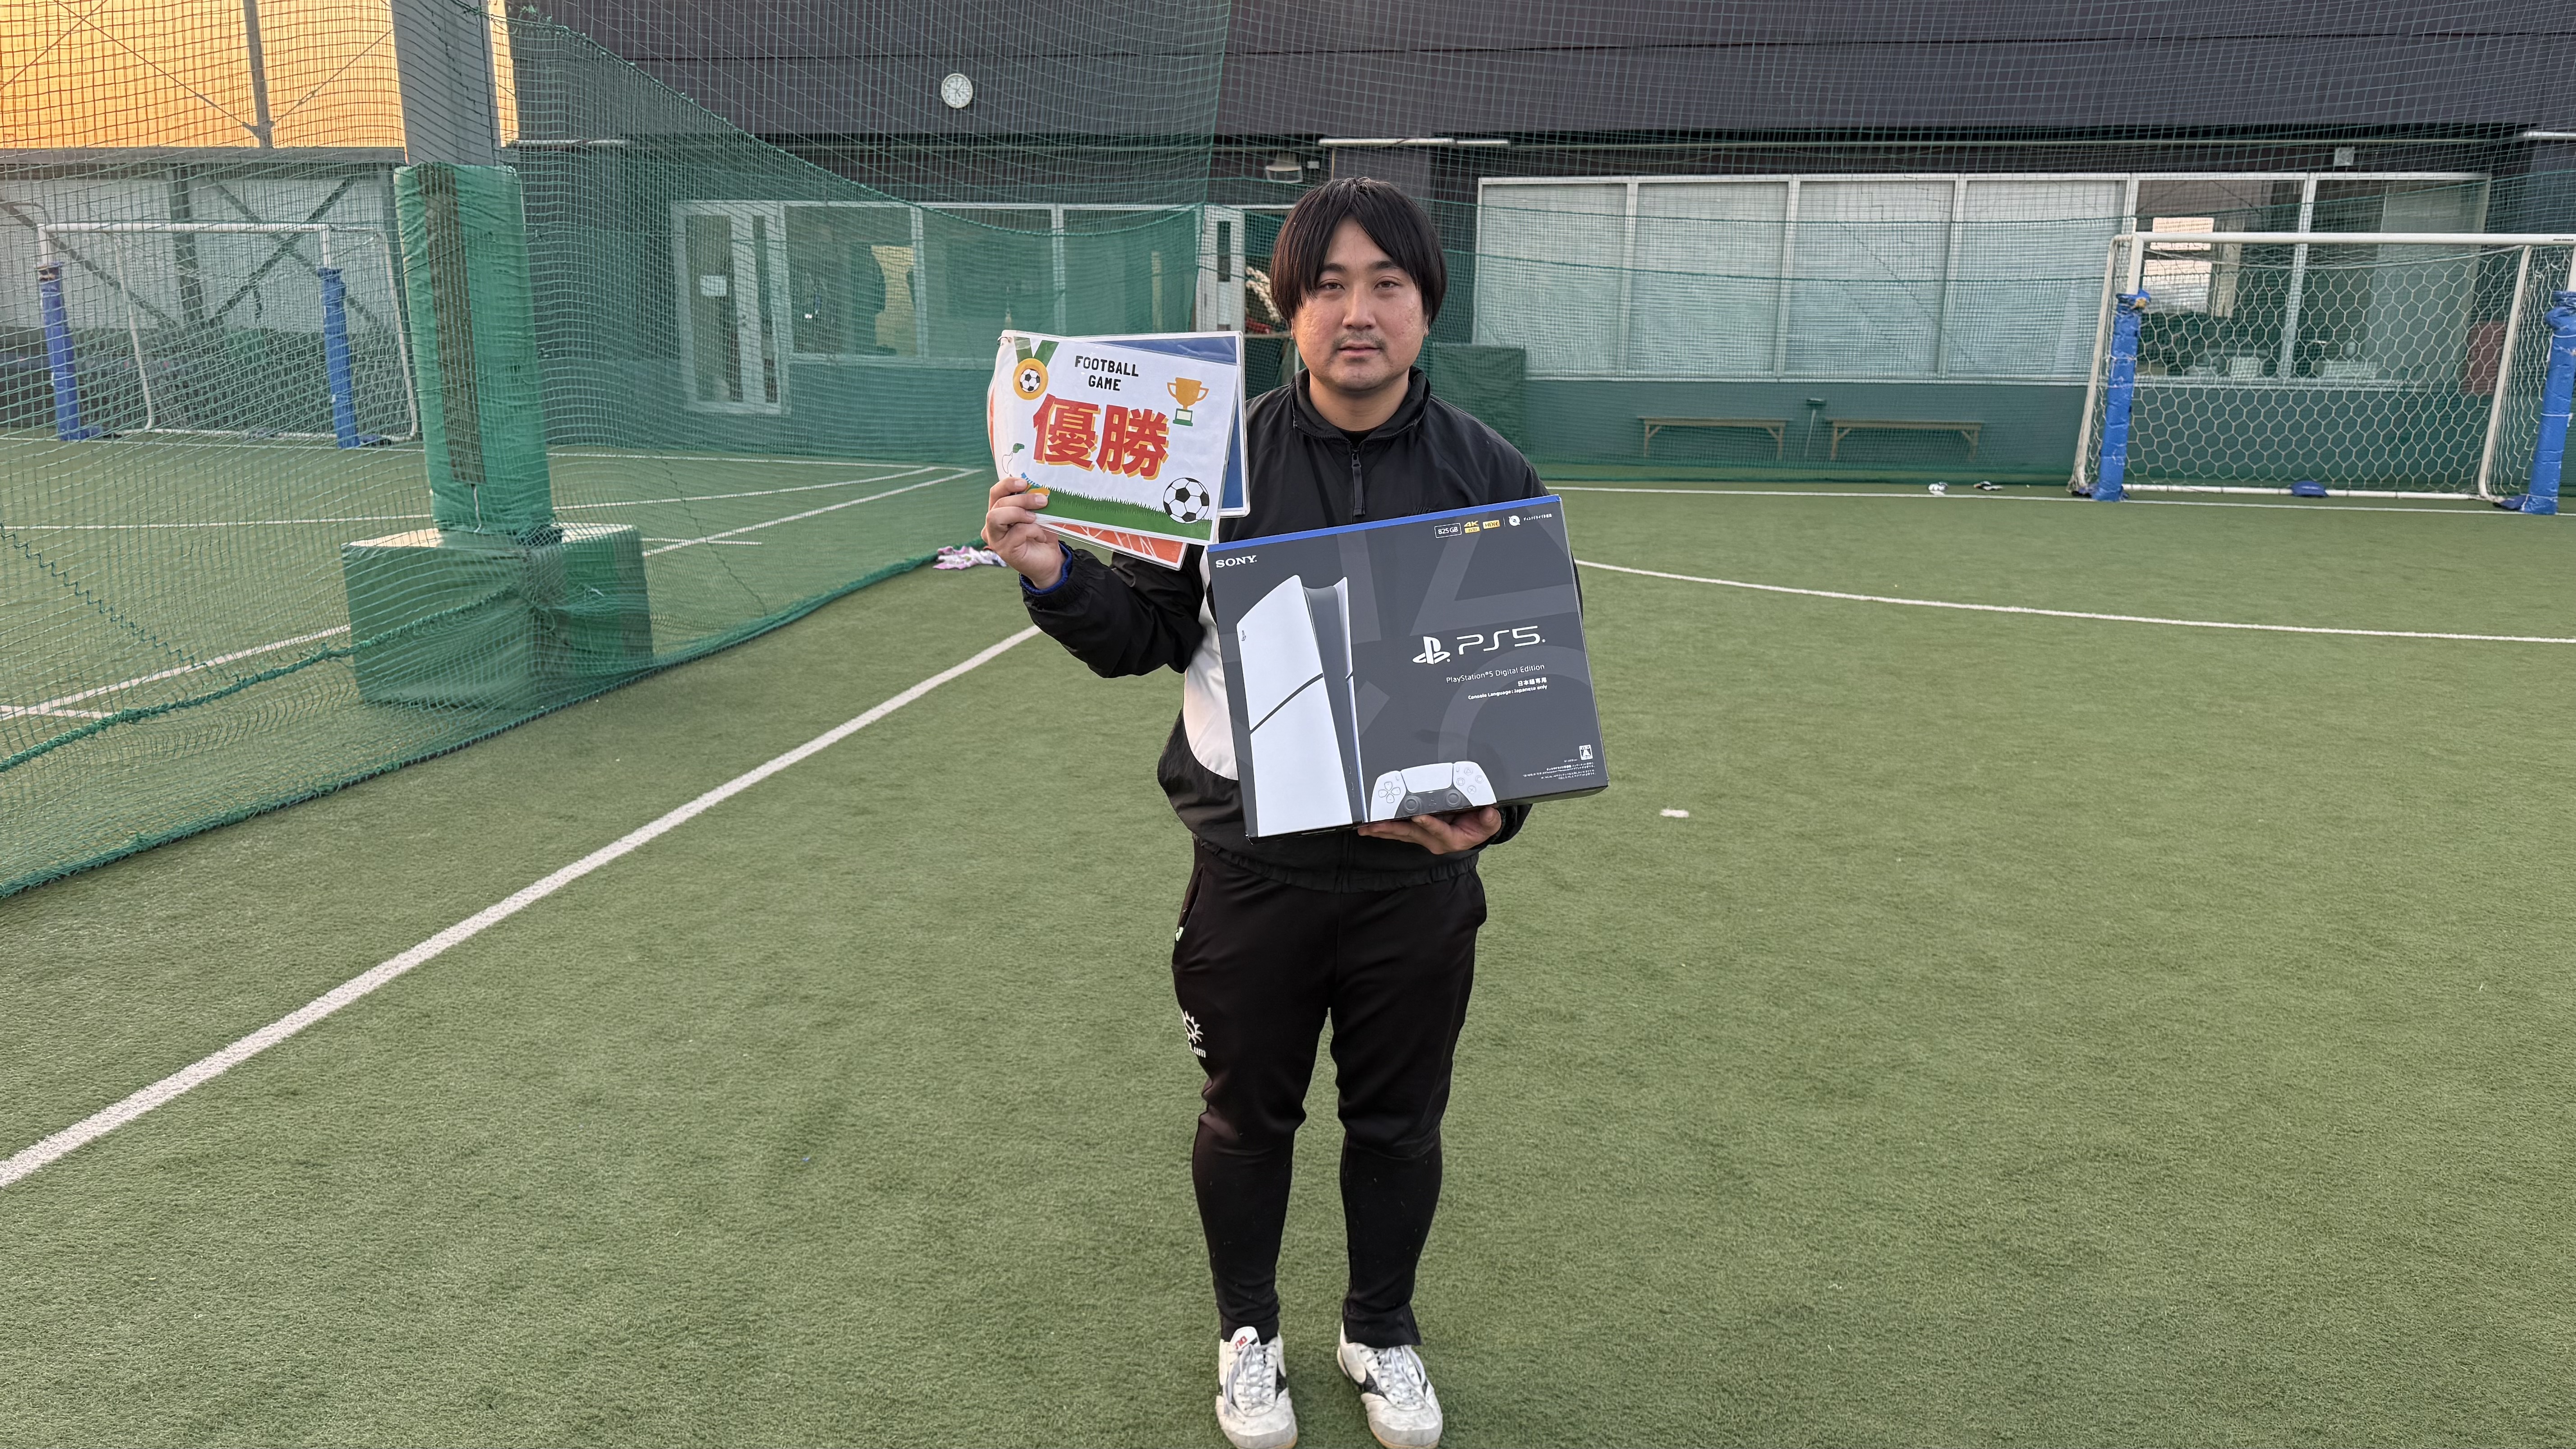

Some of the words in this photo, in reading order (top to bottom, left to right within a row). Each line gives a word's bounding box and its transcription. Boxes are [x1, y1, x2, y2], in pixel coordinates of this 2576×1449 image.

[1074, 355, 1139, 377] FOOTBALL
[1088, 375, 1122, 391] GAME
[1033, 393, 1169, 480] 優勝
[1495, 667, 1518, 676] Digital
[1520, 664, 1545, 673] Edition
